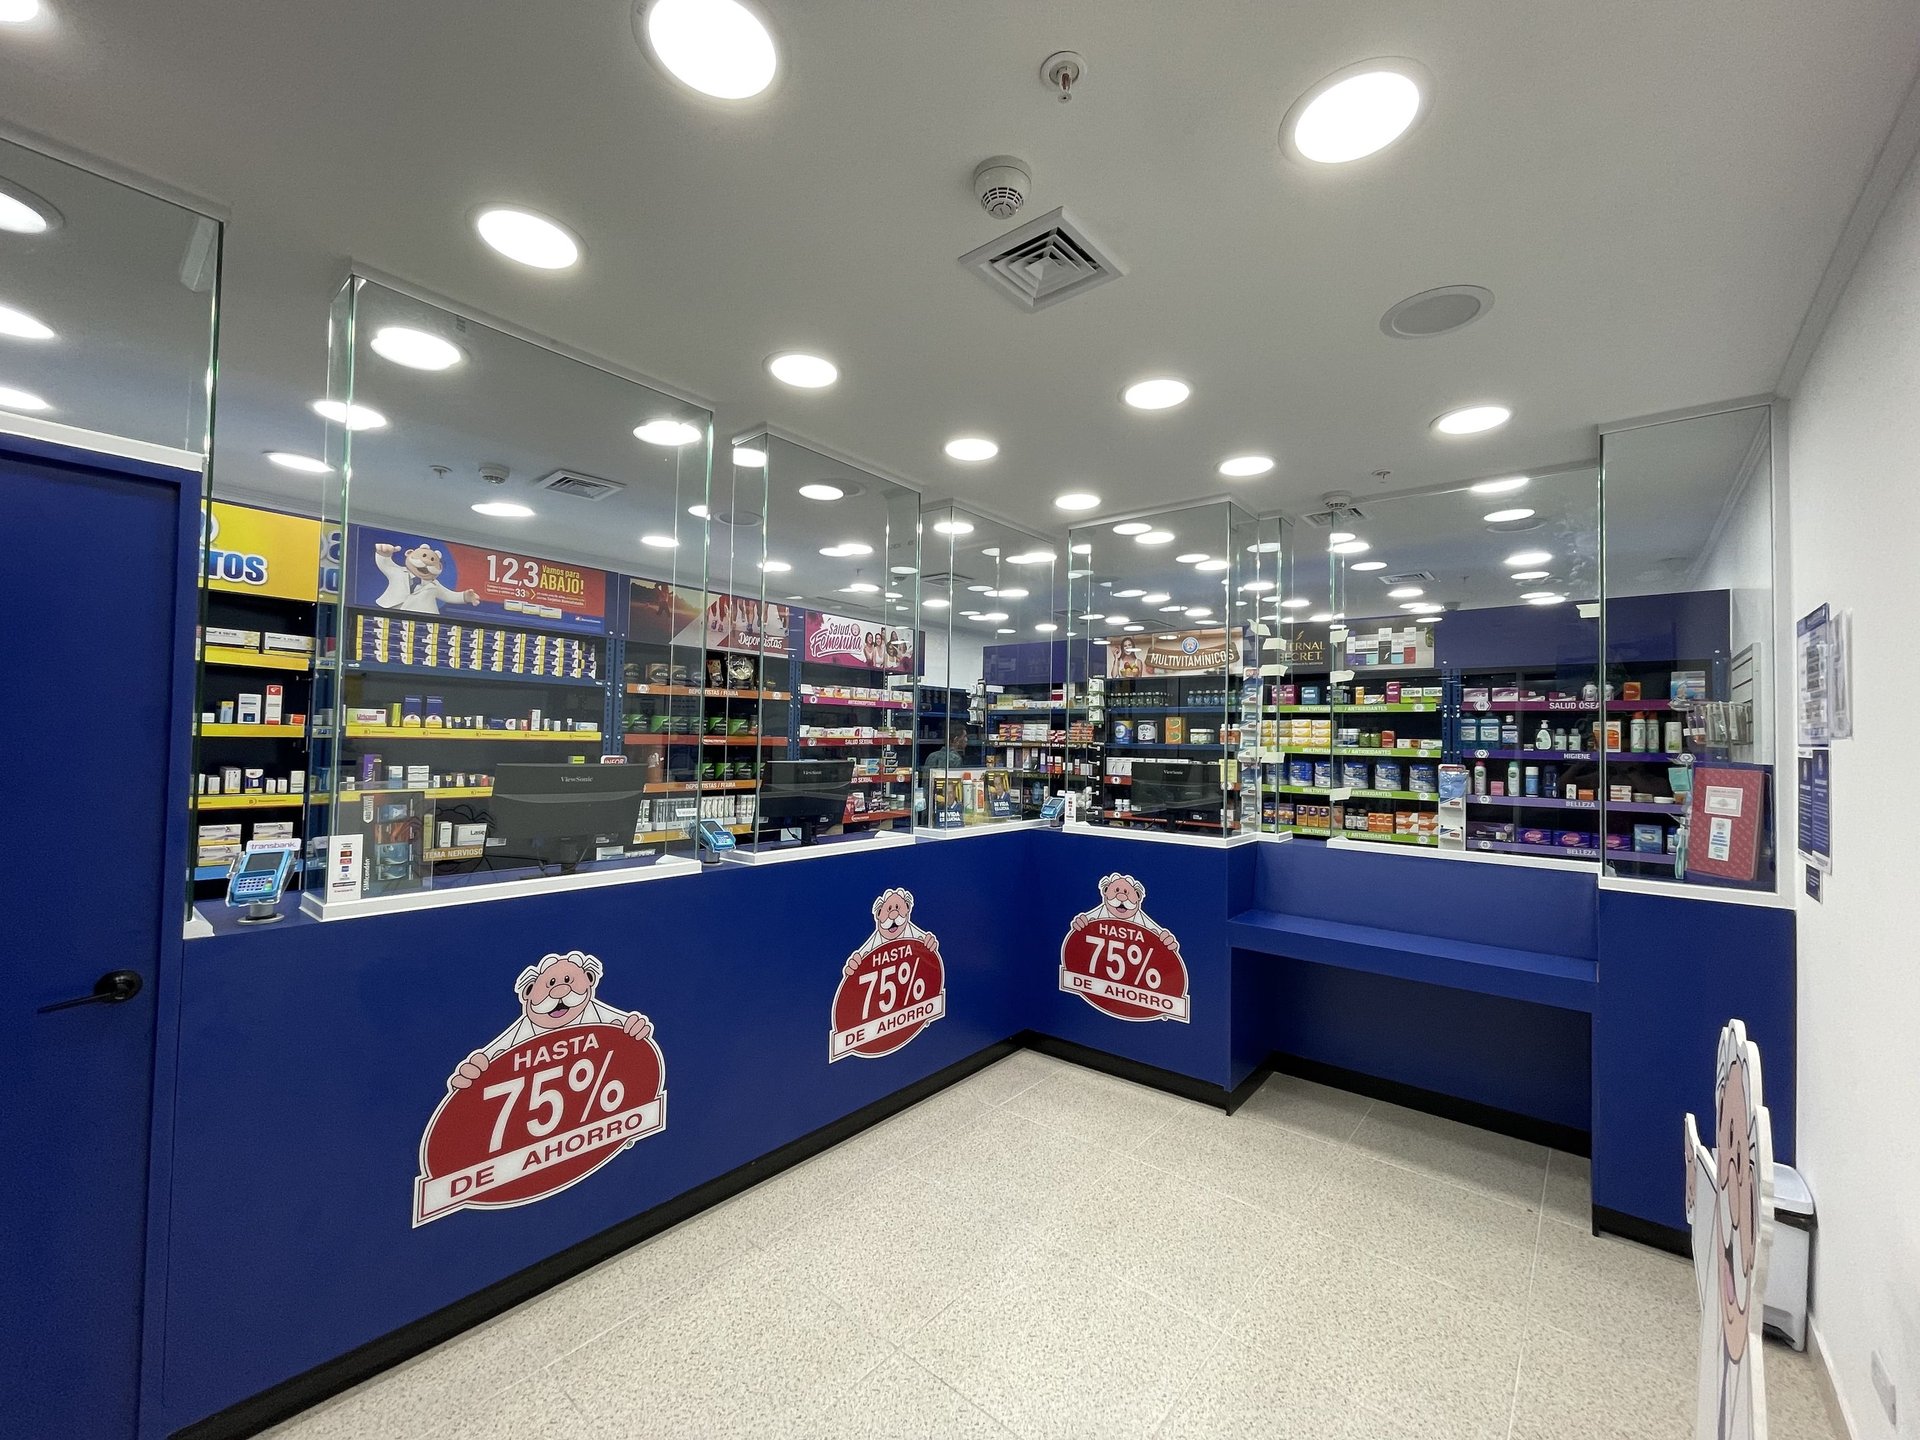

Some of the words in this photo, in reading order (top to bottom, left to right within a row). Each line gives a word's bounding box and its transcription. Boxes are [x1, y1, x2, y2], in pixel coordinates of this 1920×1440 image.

[487, 555, 539, 588] 1,2,3
[542, 565, 564, 577] Vamos
[564, 569, 580, 579] para
[540, 573, 584, 595] ABAJO!
[738, 631, 783, 649] Deporistas
[828, 623, 851, 636] Salud
[810, 629, 862, 657] Femenina
[1150, 648, 1235, 667] MULTIVITAMÍNICOS
[688, 688, 719, 696] DEPOTISTAS
[1549, 702, 1577, 710] SALUD
[1579, 701, 1600, 709] ÓSEA
[251, 841, 296, 851] transbank
[447, 847, 483, 858] NERVIOSO
[1566, 848, 1597, 856] BELLEZA
[1099, 923, 1145, 942] HASTA
[872, 945, 913, 967] HASTA
[1085, 935, 1161, 989] 75%
[859, 957, 925, 1020] 75%
[1073, 976, 1092, 990] DE
[1104, 985, 1173, 1010] AHORRO
[845, 1028, 865, 1047] DE
[877, 1003, 934, 1034] AHORRO
[513, 1033, 599, 1072] HASTA
[483, 1050, 625, 1153] 75%
[450, 1165, 495, 1198] DE
[522, 1113, 643, 1171] AHORRO
